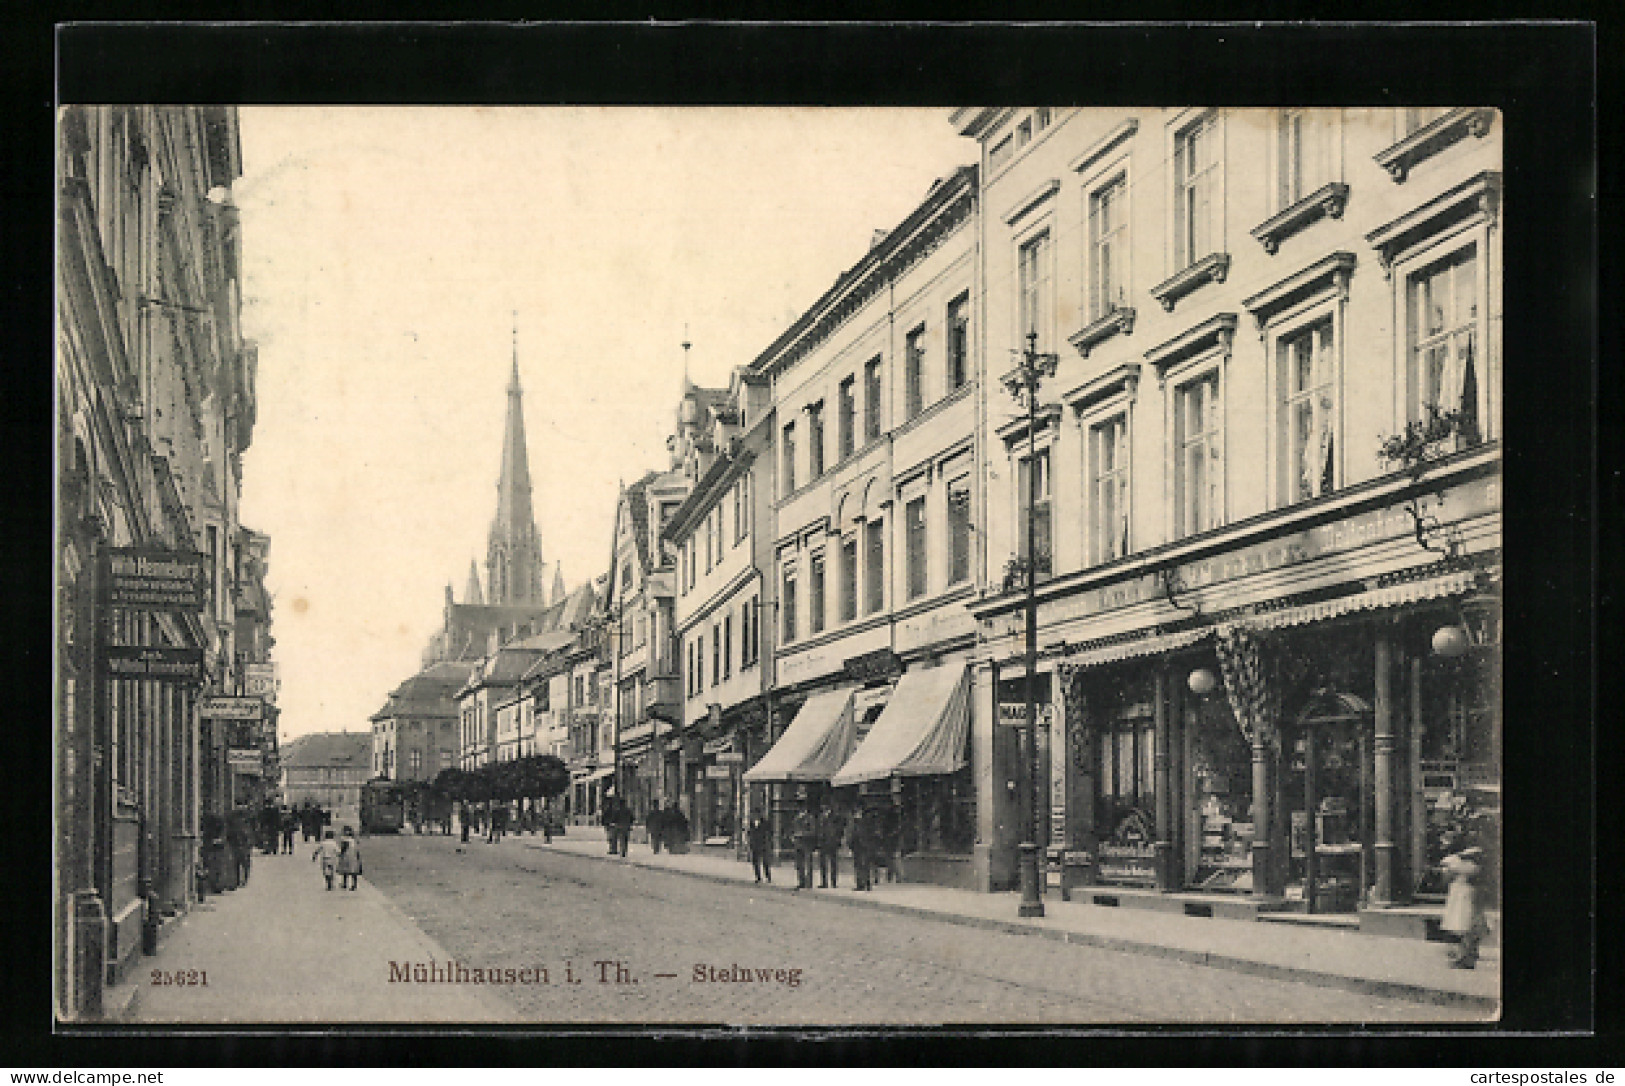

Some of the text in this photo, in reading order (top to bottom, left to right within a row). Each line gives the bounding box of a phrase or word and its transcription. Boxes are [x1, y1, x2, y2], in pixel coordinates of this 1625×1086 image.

[151, 969, 208, 987] 25621
[387, 960, 549, 984] Mühlhausen
[566, 960, 582, 984] i.
[593, 960, 639, 984] Th.
[692, 963, 803, 987] Steinweg
